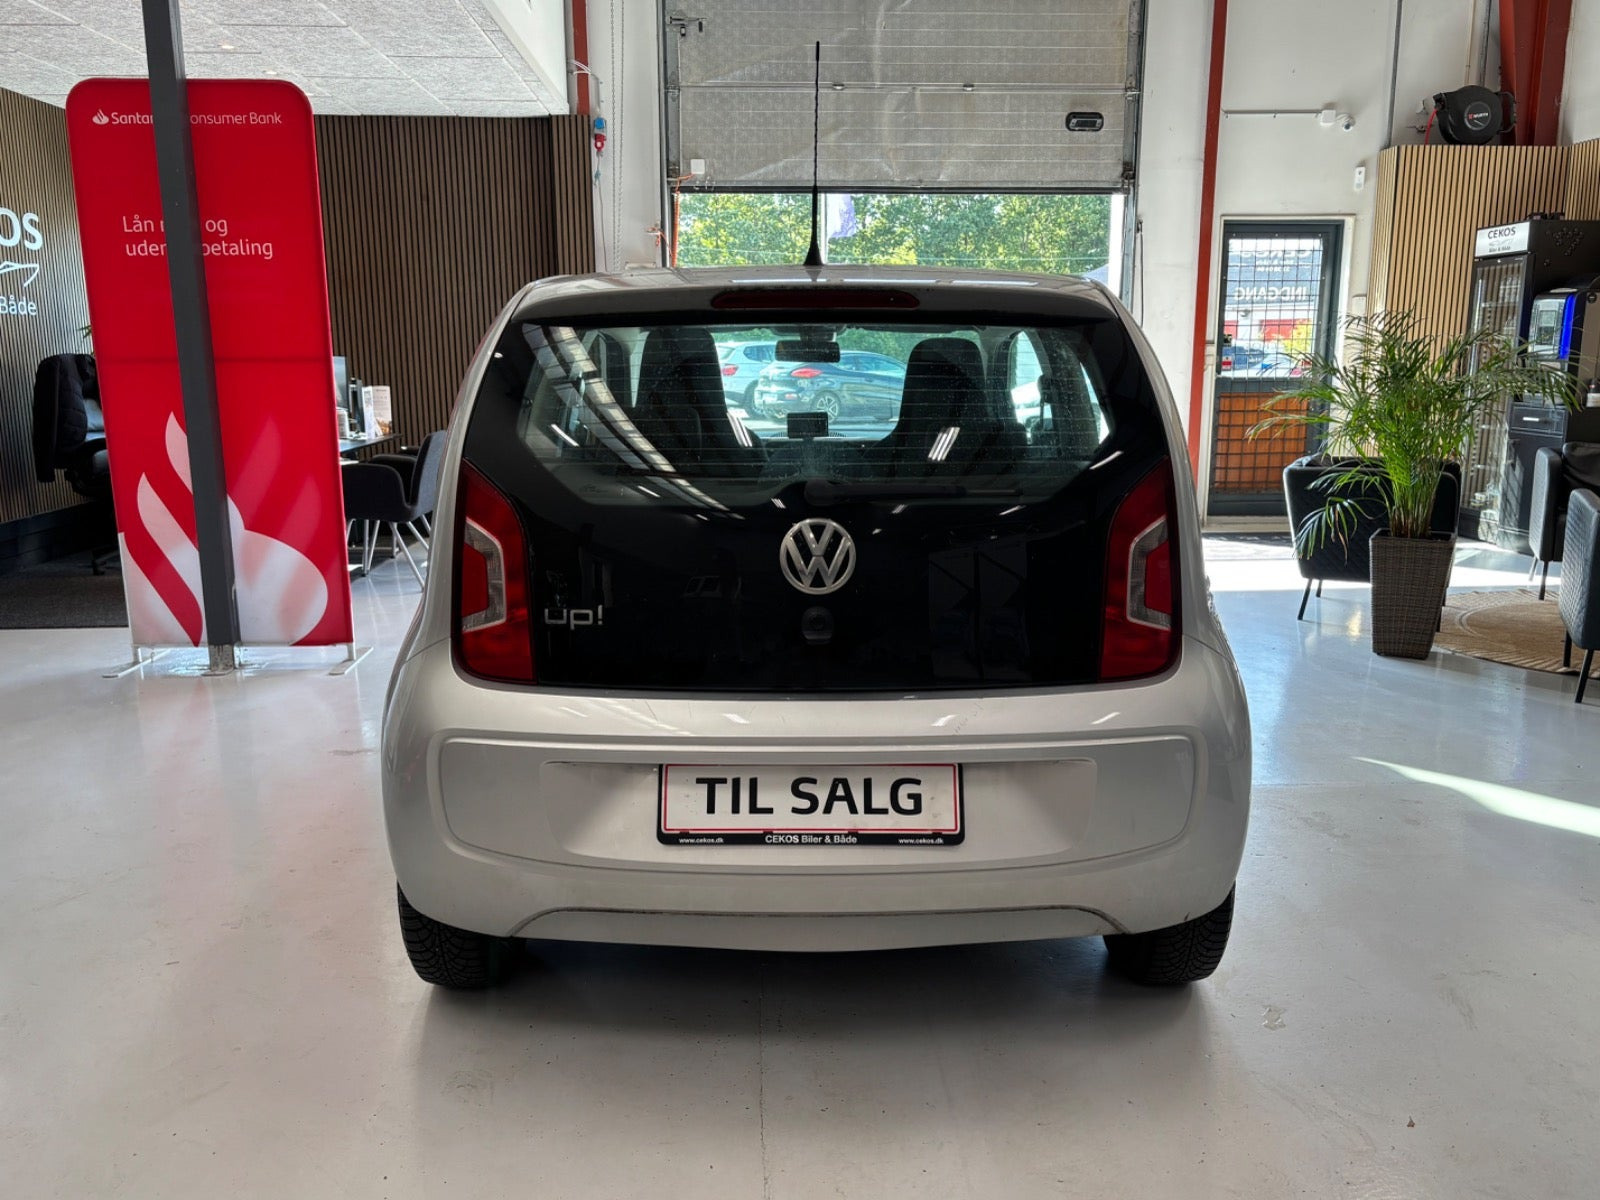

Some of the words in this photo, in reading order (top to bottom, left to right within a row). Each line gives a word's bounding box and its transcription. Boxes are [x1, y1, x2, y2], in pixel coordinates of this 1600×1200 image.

[111, 112, 153, 125] Santa
[189, 112, 247, 125] onsumer
[250, 112, 282, 125] Bank
[122, 214, 154, 232] Lån
[205, 219, 228, 236] og
[1488, 227, 1516, 239] CEKOS
[544, 605, 603, 630] up!
[695, 777, 774, 814] TIL
[790, 777, 922, 815] SALG
[679, 837, 724, 845] www.cekos.dk
[765, 835, 799, 844] CEKOS
[801, 834, 822, 844] Biler
[824, 835, 831, 844] &
[834, 834, 857, 844] Både
[899, 837, 944, 845] www.cekos.dk
